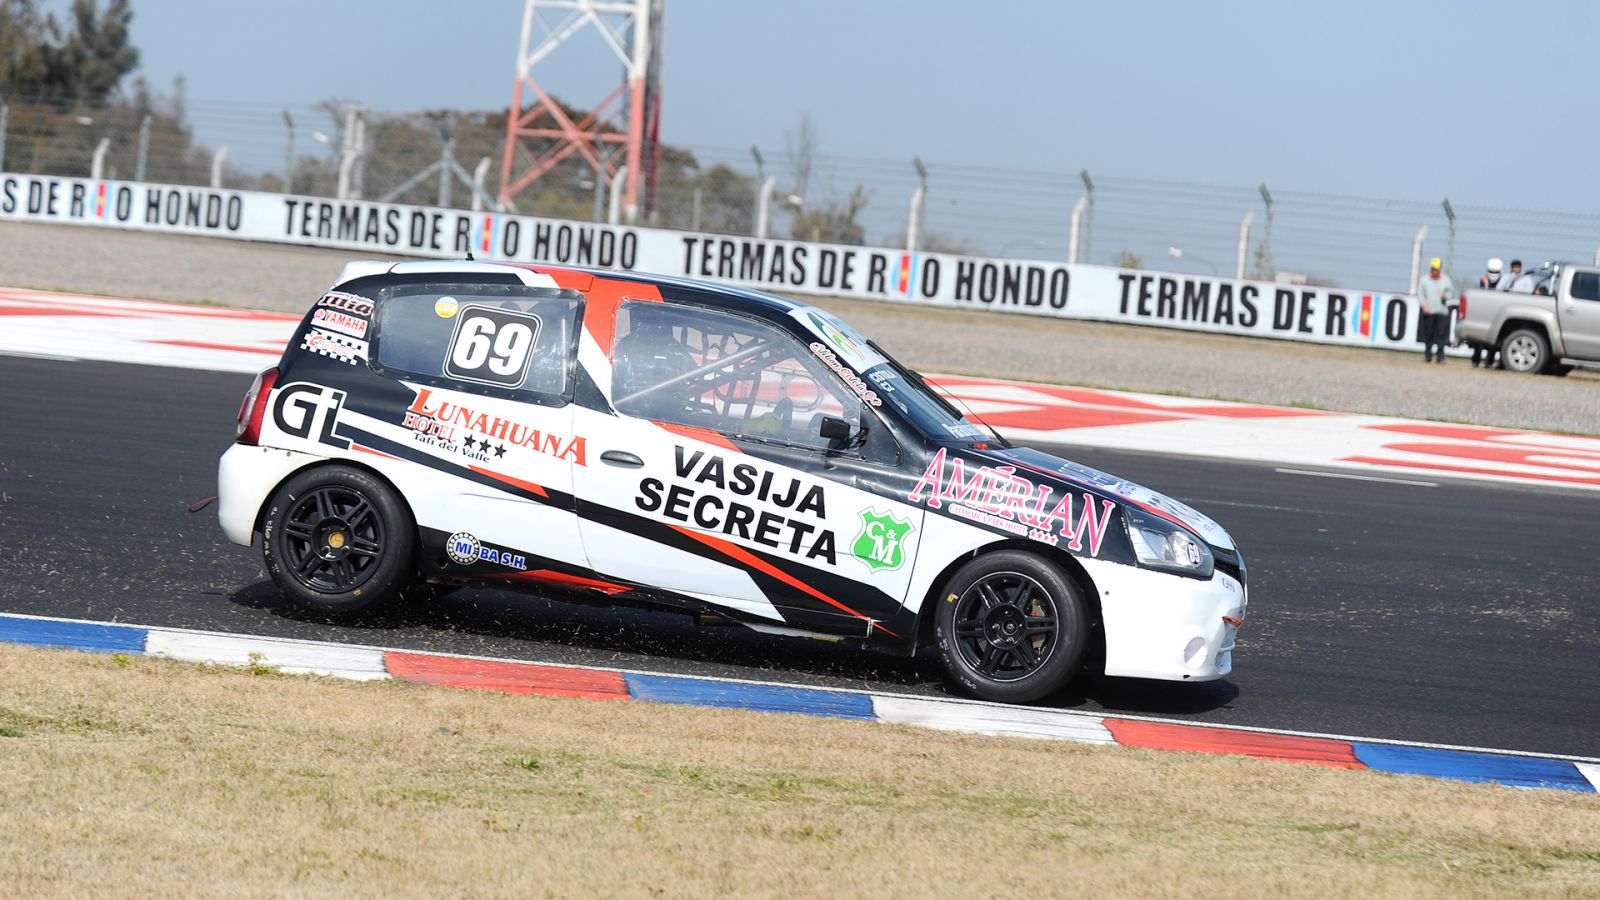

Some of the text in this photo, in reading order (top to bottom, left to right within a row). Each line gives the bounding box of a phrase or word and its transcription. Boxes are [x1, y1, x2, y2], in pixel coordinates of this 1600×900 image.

[28, 180, 59, 215] DE
[146, 189, 243, 231] HONDO
[284, 200, 400, 246] TERMAS
[410, 210, 441, 250] DE
[534, 224, 638, 270] HONDO
[682, 238, 807, 286] TERMAS
[818, 250, 855, 290] DE
[955, 261, 1071, 309] HONDO
[325, 312, 366, 332] YAMAHA
[1118, 274, 1259, 328] TERMAS
[1272, 289, 1315, 335] DE
[453, 317, 533, 376] 69
[402, 413, 457, 442] HOTEL
[409, 387, 588, 468] LUNAHUANA
[438, 441, 458, 453] del
[462, 448, 491, 464] Valle
[674, 445, 826, 519] VASIJA
[635, 477, 836, 566] SECRETA
